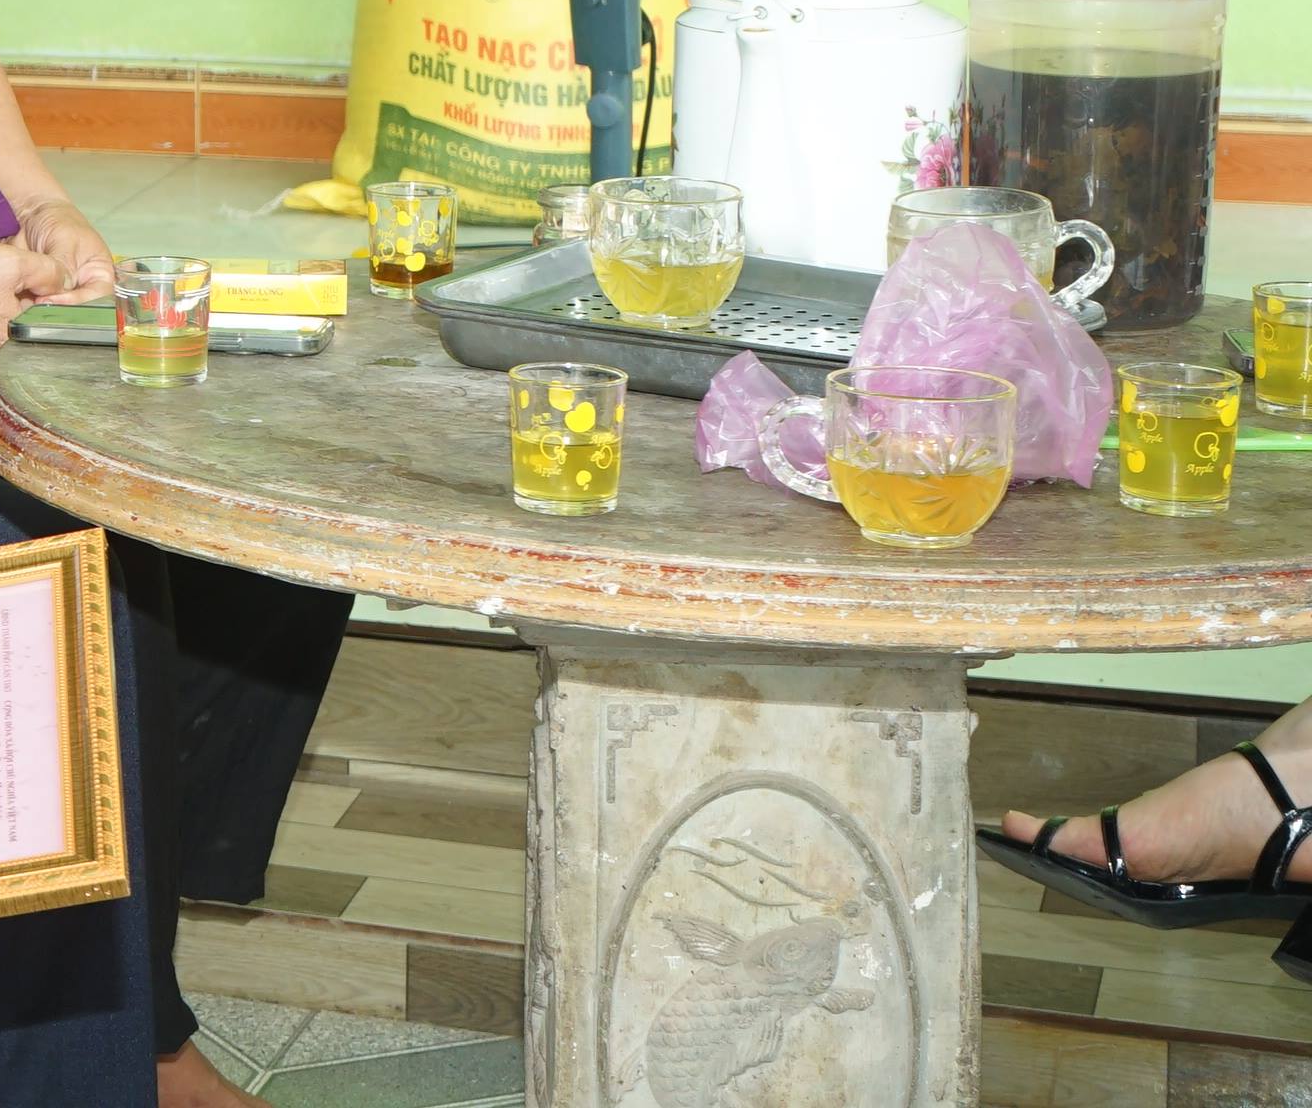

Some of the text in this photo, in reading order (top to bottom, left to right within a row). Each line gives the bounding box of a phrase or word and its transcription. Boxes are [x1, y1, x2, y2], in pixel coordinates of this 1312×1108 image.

[463, 67, 549, 109] LƯỢNG
[508, 159, 532, 177] TY
[1185, 463, 1214, 476] Apple
